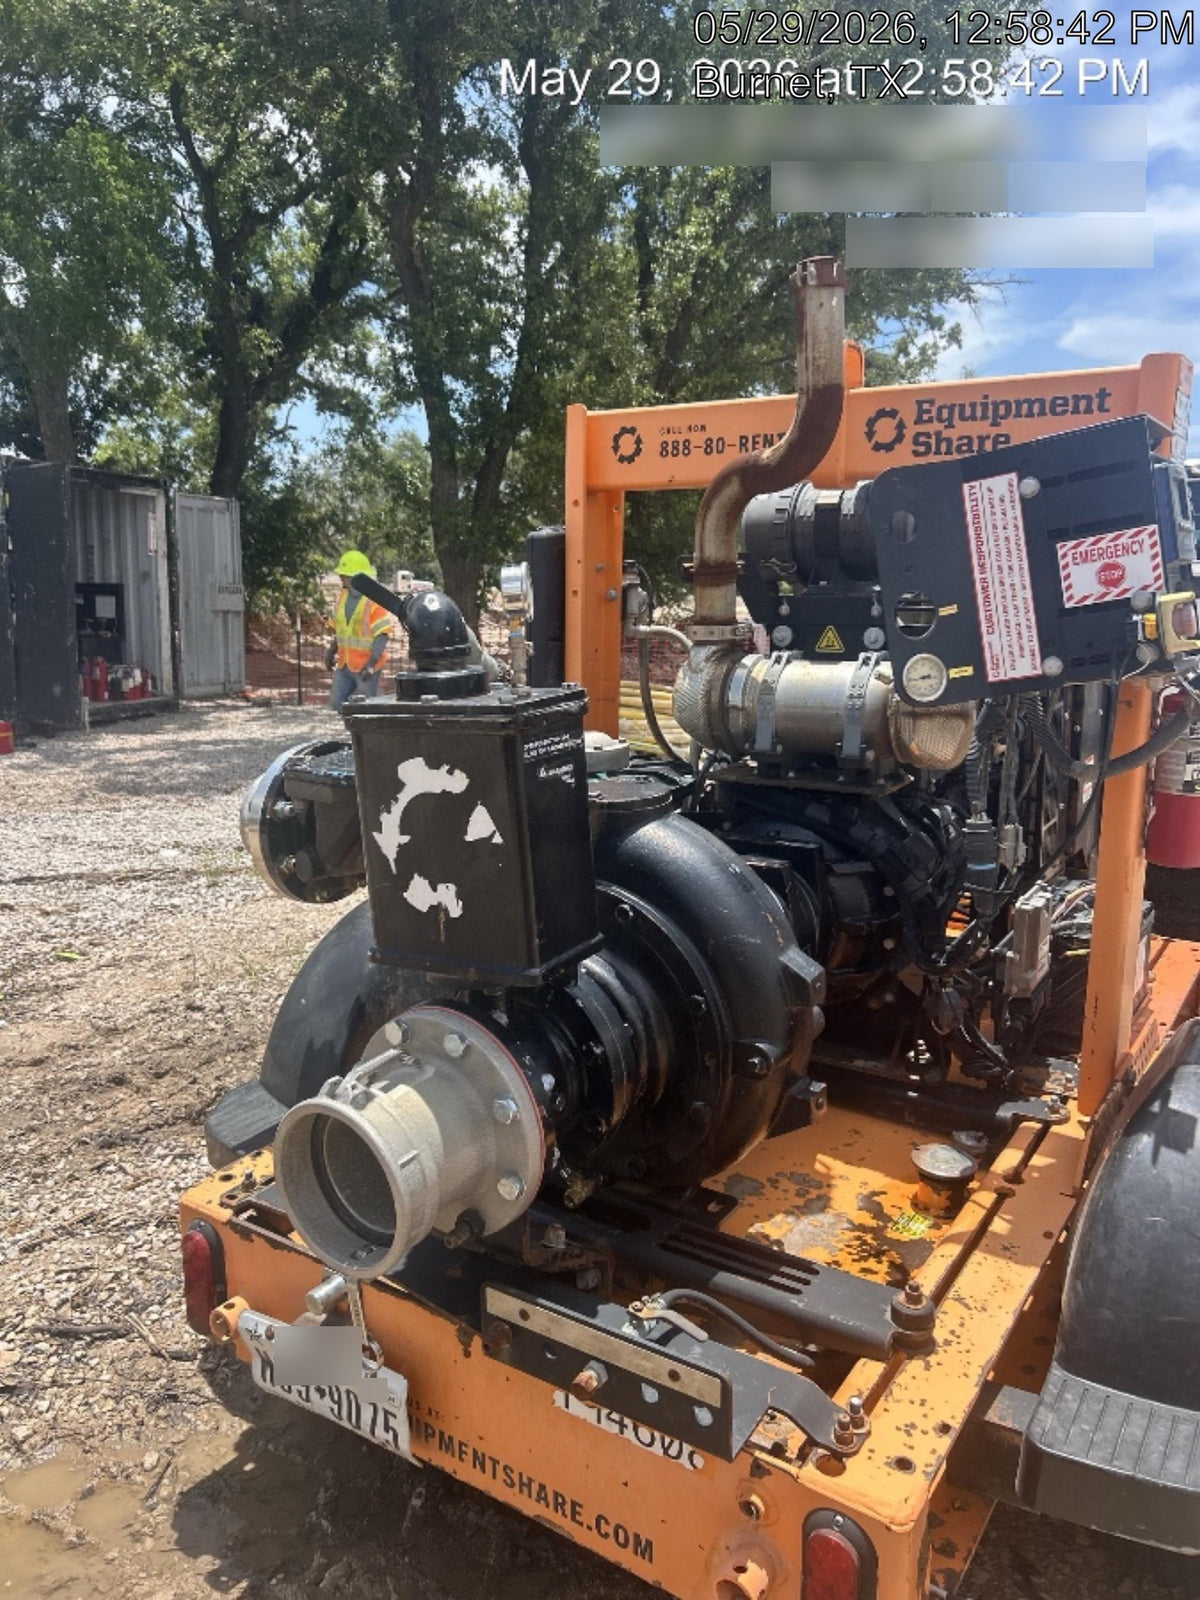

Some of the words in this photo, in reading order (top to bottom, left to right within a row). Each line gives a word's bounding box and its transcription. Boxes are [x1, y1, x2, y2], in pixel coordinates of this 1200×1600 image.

[913, 387, 1112, 430] Equipment
[911, 431, 1012, 458] Share
[1071, 539, 1145, 566] EMERGENCY
[1099, 569, 1124, 581] STOP
